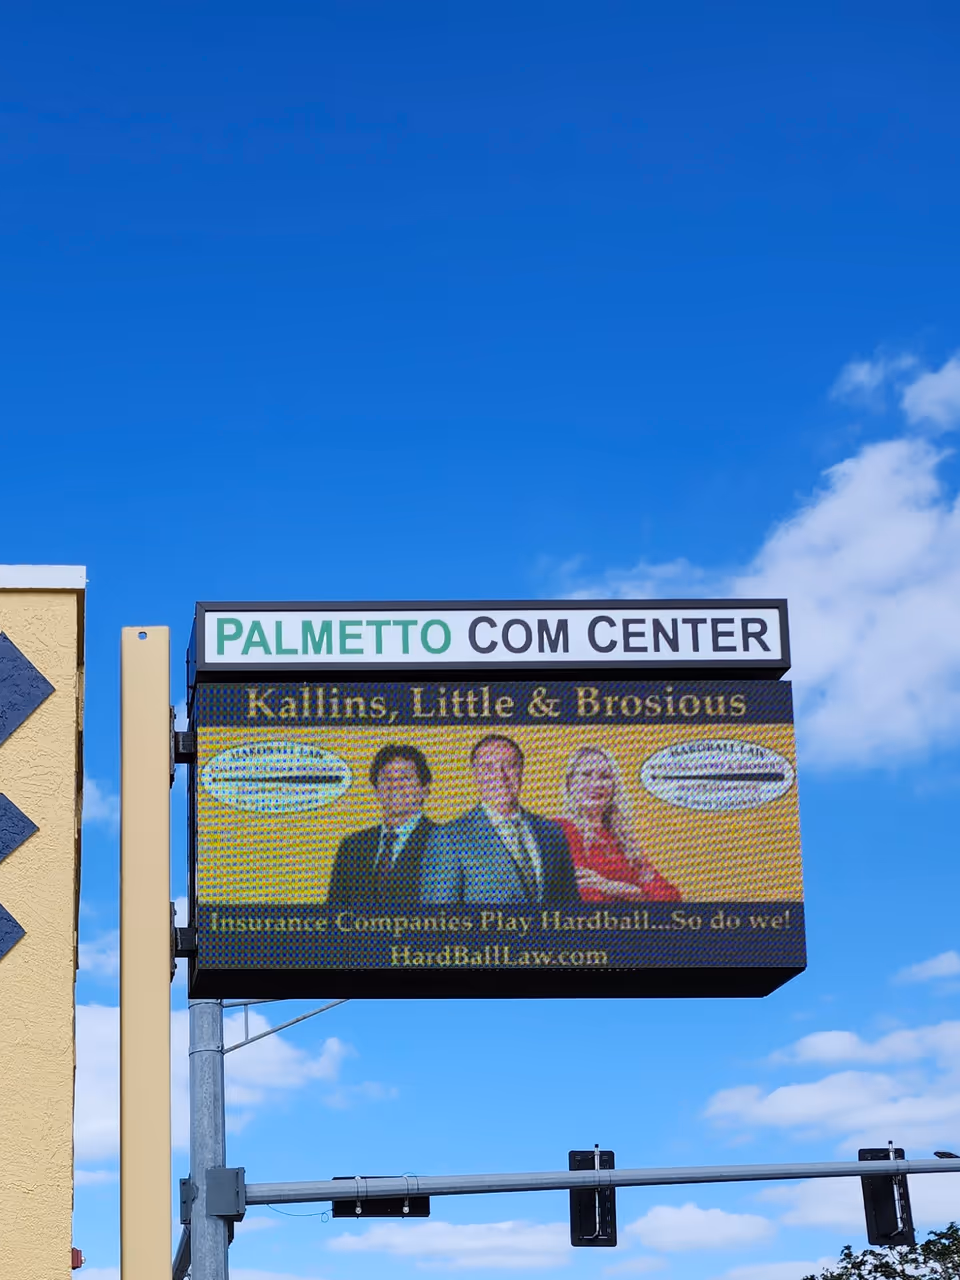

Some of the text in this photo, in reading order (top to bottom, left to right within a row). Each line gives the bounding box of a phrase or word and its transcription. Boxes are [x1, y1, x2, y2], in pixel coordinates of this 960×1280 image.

[216, 615, 772, 656] PALMETTO COM CENTER
[245, 685, 747, 724] Kallins, Little & Brosious
[210, 912, 329, 931] Insurance
[337, 911, 474, 938] Companies
[479, 911, 532, 936] Play
[710, 909, 741, 930] do
[748, 909, 791, 930] we!
[390, 945, 608, 967] HardBallLaw.com
